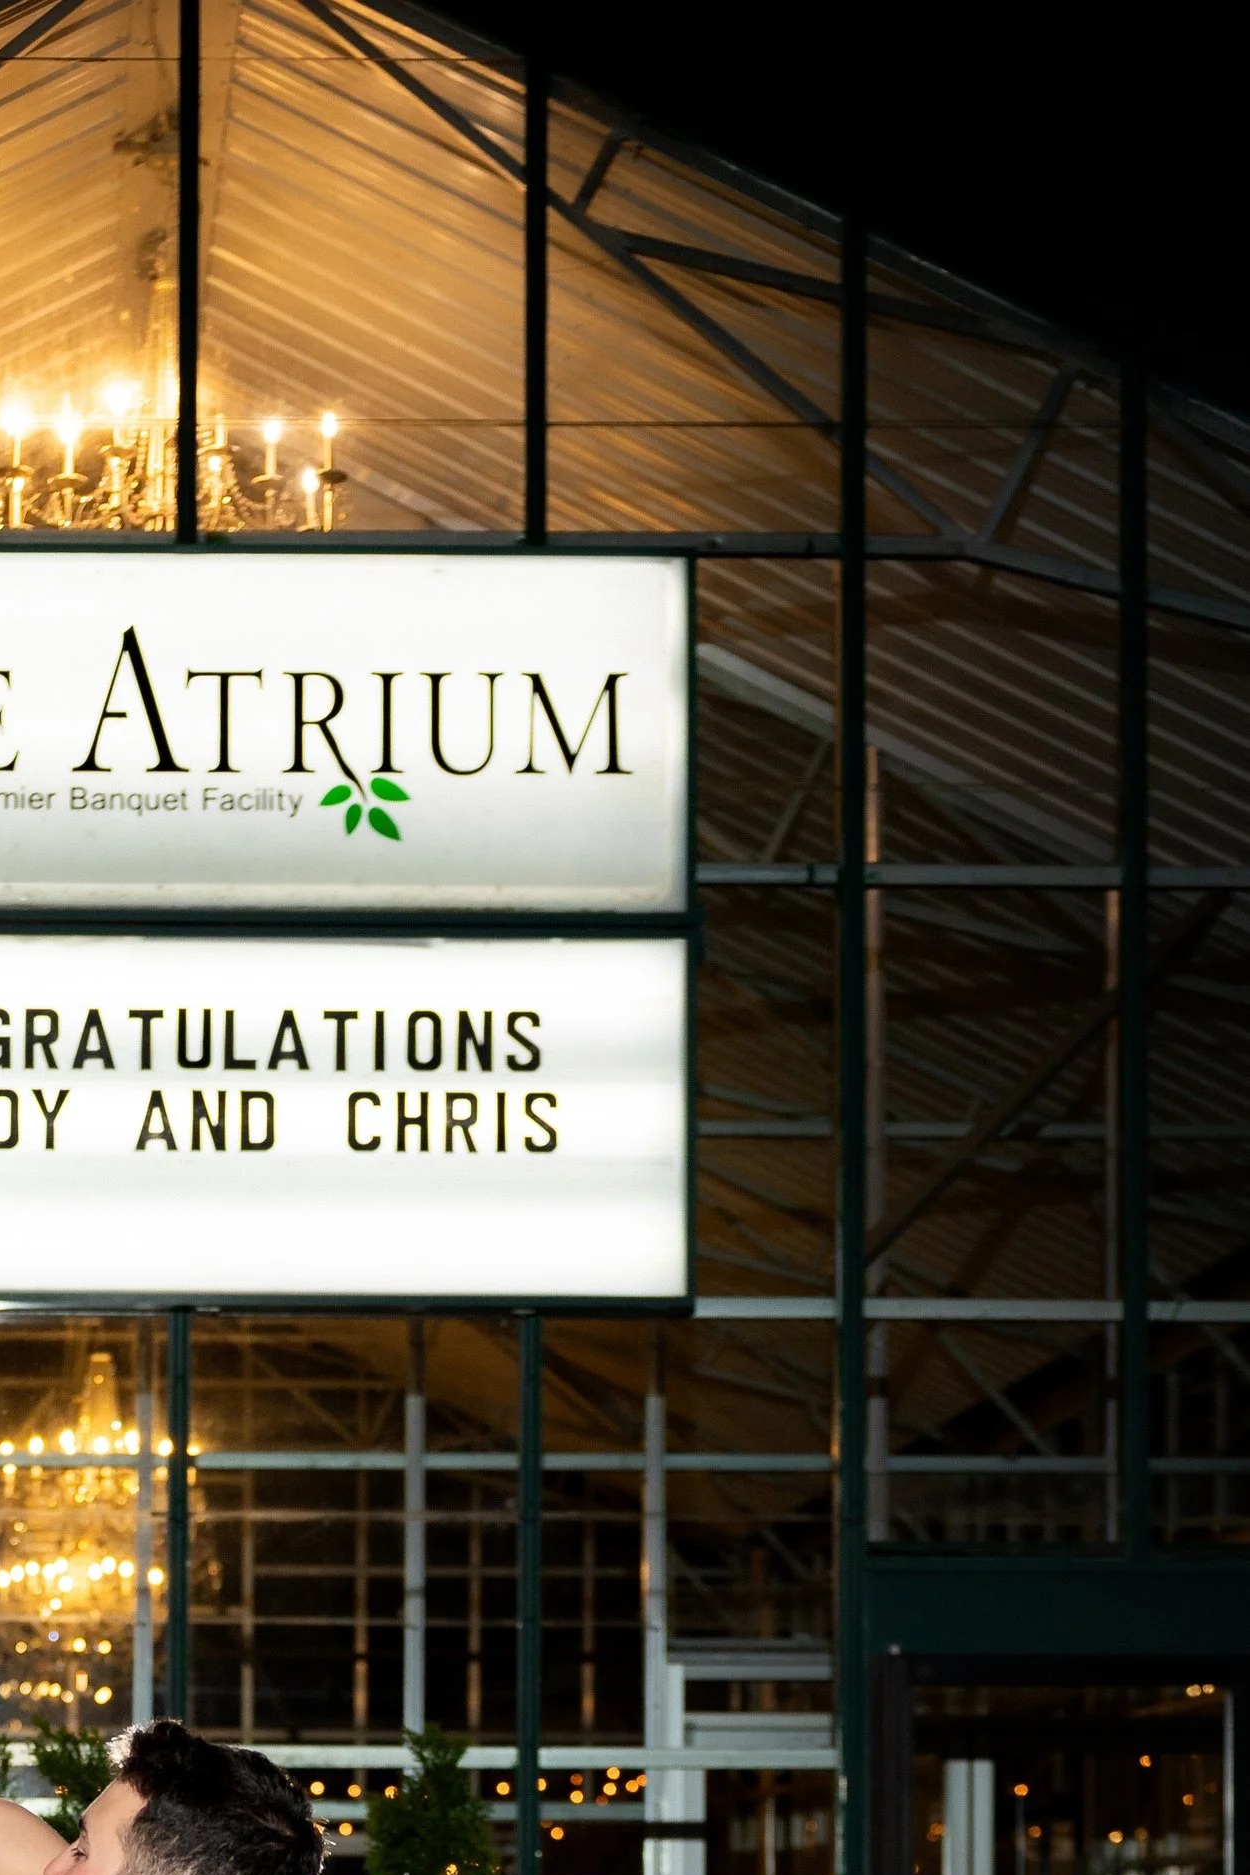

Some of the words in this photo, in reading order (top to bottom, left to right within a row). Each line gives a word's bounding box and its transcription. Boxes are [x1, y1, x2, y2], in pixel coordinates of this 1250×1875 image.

[71, 625, 635, 778] ATRIUM
[69, 786, 188, 818] Banquet
[202, 787, 304, 819] Facility
[134, 1089, 276, 1153] AND
[346, 1090, 559, 1154] CHRIS
